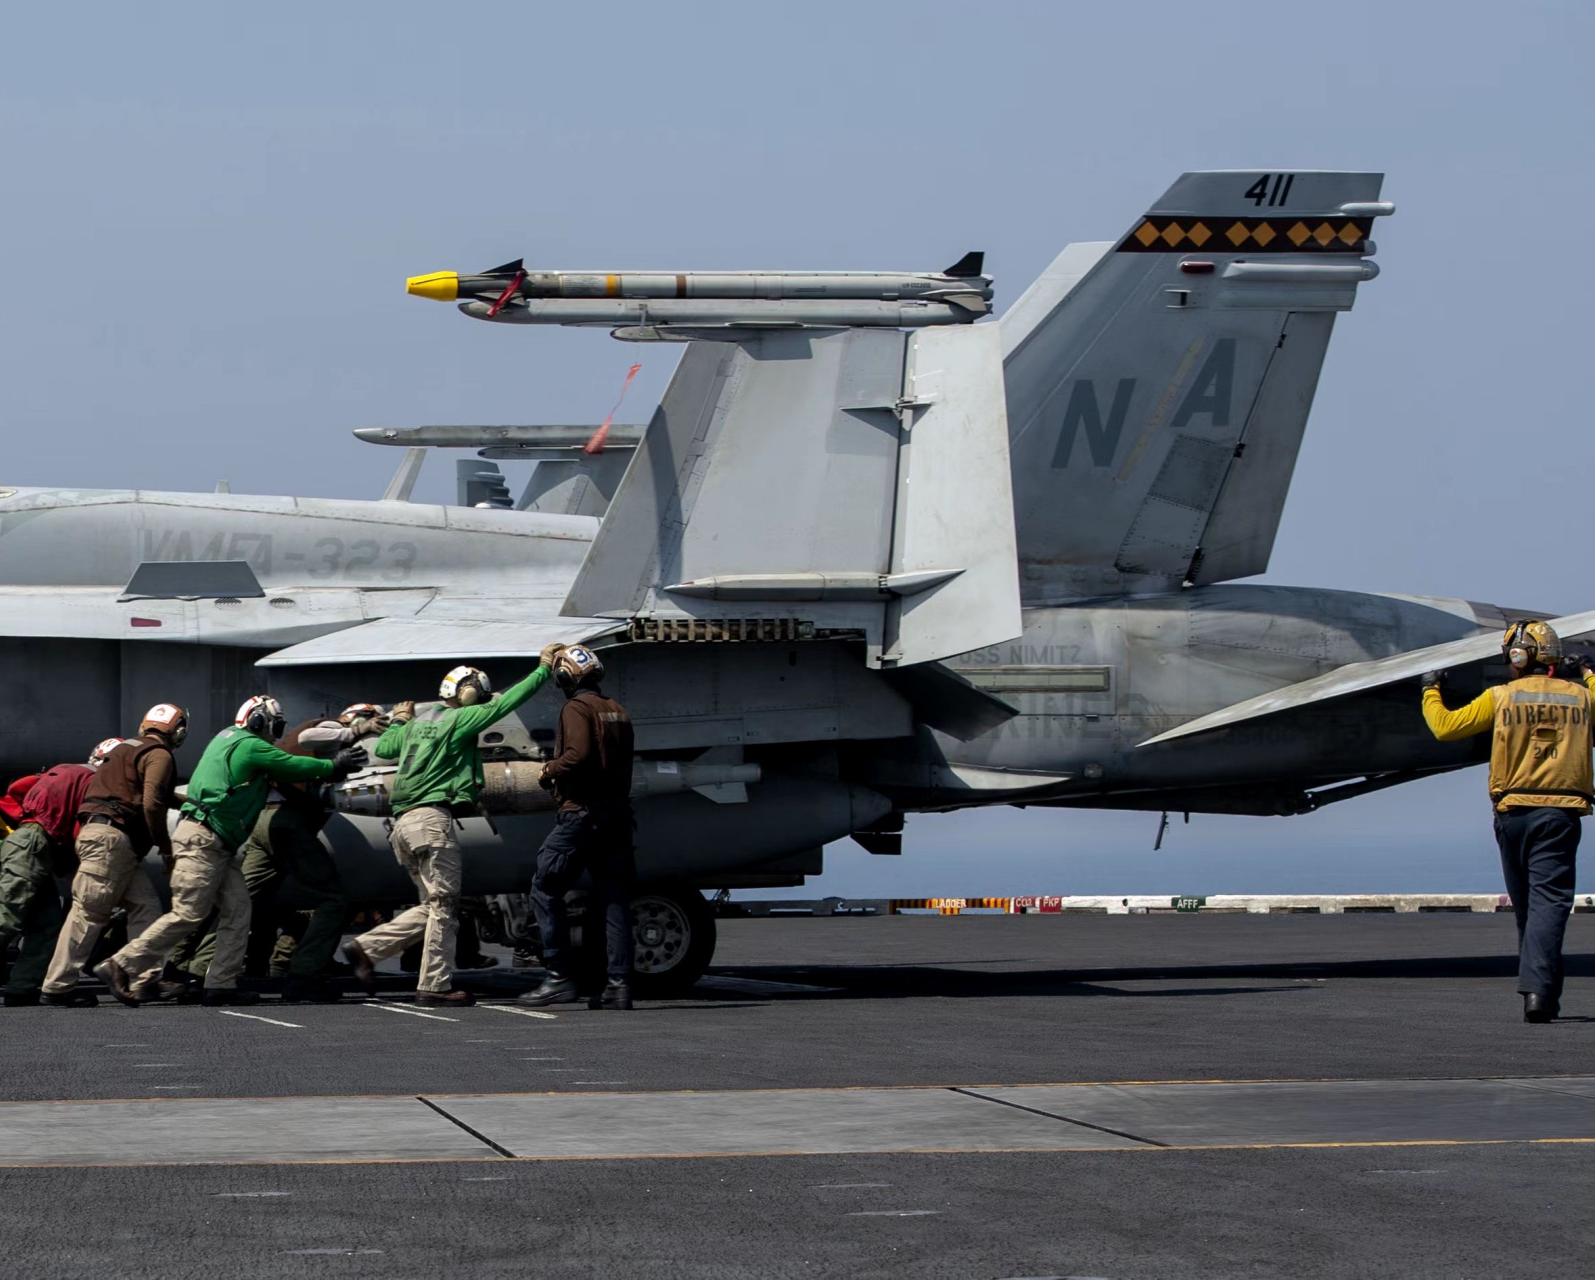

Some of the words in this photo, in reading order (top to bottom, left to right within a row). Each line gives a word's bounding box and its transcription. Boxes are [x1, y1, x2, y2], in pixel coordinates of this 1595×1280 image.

[1244, 174, 1294, 206] 411
[1169, 338, 1236, 427] A
[1052, 378, 1137, 468] N
[1010, 644, 1082, 665] NIMITZ
[936, 898, 966, 908] LADDER
[1043, 897, 1059, 907] PKP
[1177, 899, 1198, 909] AFFF
